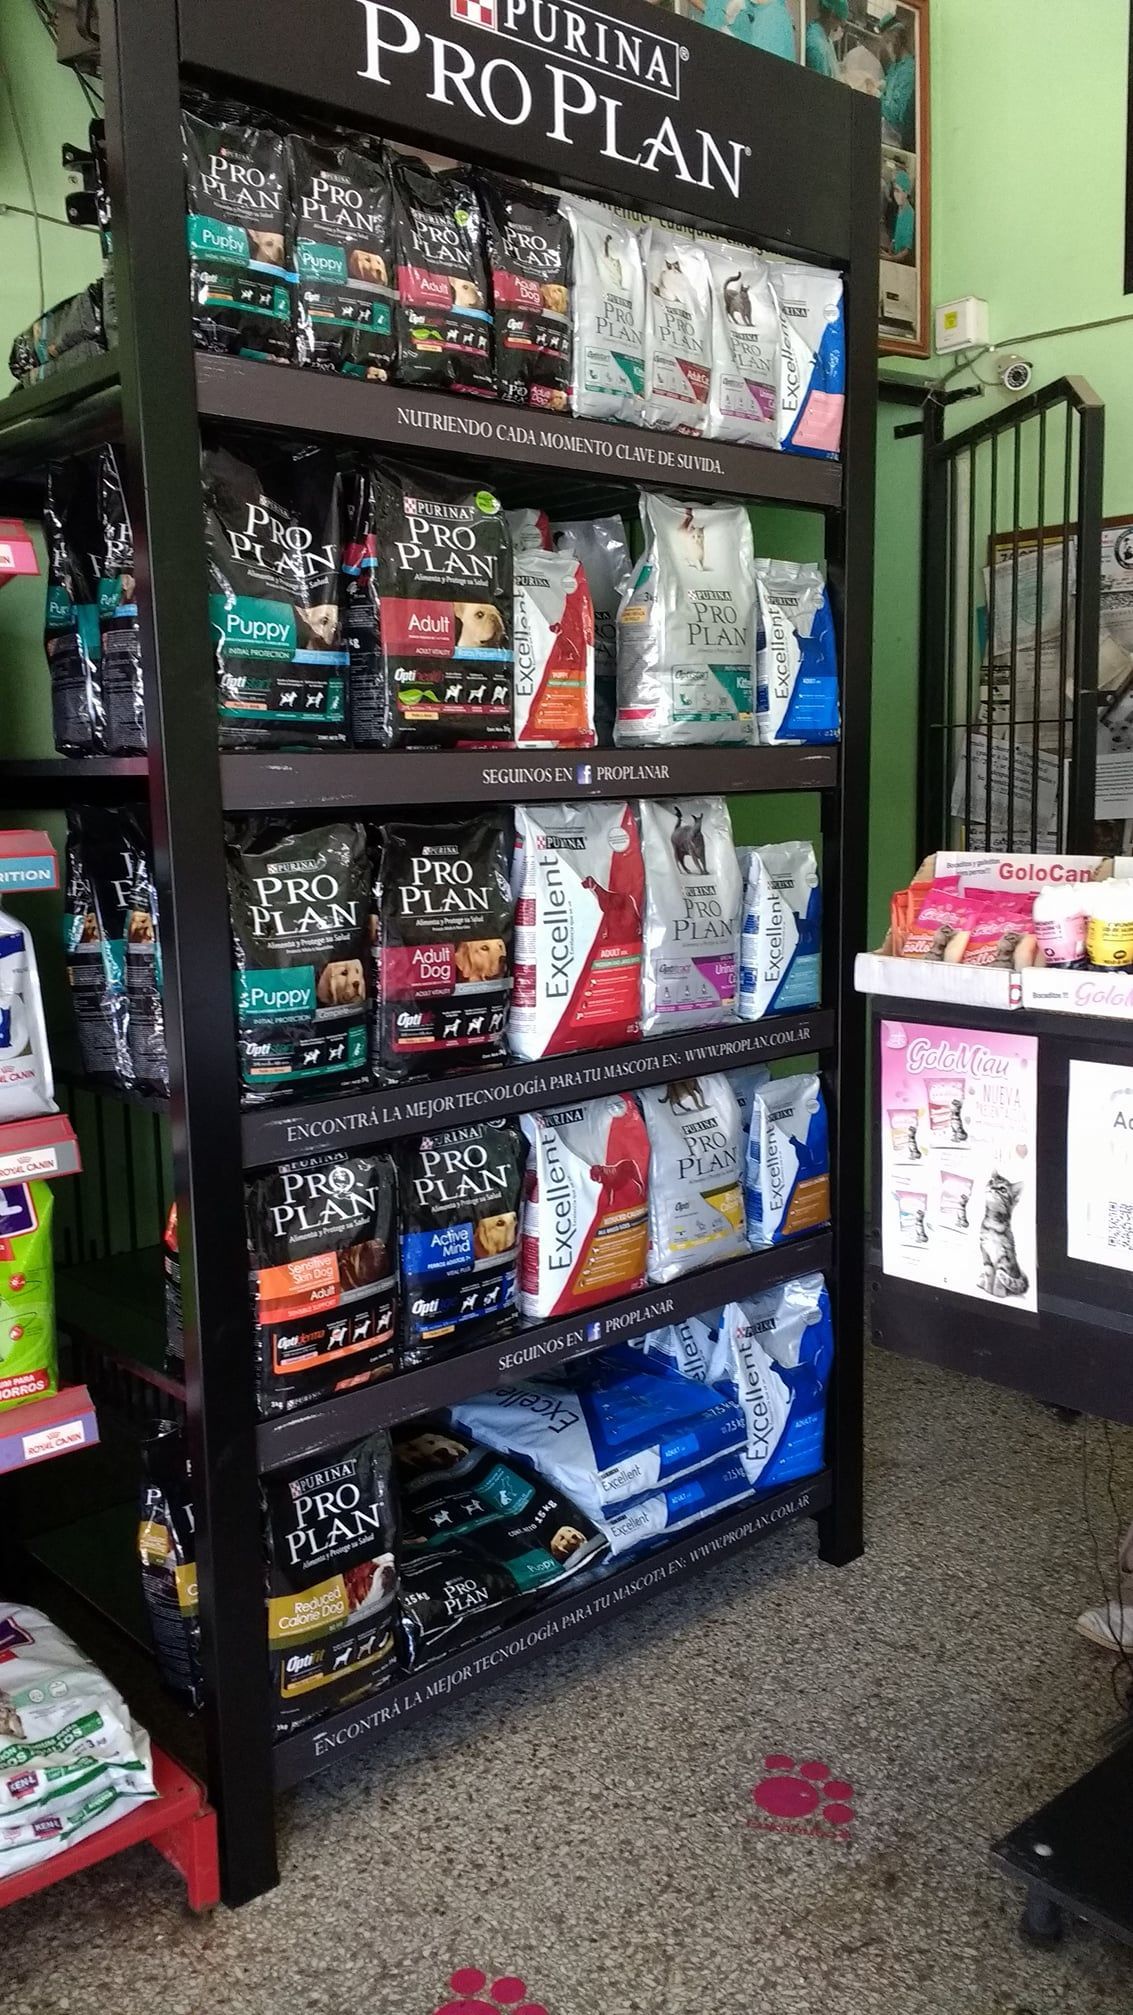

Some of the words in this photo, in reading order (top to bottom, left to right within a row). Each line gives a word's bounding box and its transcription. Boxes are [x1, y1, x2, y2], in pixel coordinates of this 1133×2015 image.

[357, 0, 532, 126] PRO
[208, 154, 265, 188] PRO
[199, 172, 283, 210] PLAN
[310, 176, 363, 209] PRO
[300, 196, 375, 233] PLAN
[202, 229, 245, 252] Puppy
[415, 221, 460, 246] PRO
[503, 225, 547, 251] PRO
[302, 252, 343, 272] Puppy
[502, 237, 563, 268] PLAN
[420, 278, 449, 295] Adult
[514, 276, 538, 291] Adult
[520, 288, 541, 304] Dog
[603, 301, 634, 326] PRO
[665, 312, 695, 336] PRO
[595, 316, 643, 345] PLAN
[659, 325, 705, 353] PLAN
[397, 407, 493, 438] NUTRIENDO
[496, 424, 536, 445] CADA
[540, 432, 613, 457] MOMENTO
[616, 444, 655, 464] CLAVE
[657, 450, 675, 467] DE
[417, 502, 469, 520] PURINA
[243, 502, 313, 551] PRO
[405, 515, 476, 551] PRO
[226, 529, 336, 583] PLAN
[394, 541, 497, 579] PLAN
[515, 576, 550, 588] PURINA
[696, 591, 732, 601] PURINA
[227, 614, 290, 641] Puppy
[408, 613, 451, 633] Adult
[692, 602, 738, 625] PRO
[513, 589, 537, 697] Excellent
[687, 622, 748, 647] PLAN
[769, 607, 790, 699] Excellent
[482, 767, 552, 784] SEGUINOS
[554, 767, 573, 782] EN
[597, 765, 670, 781] PROPLANAR
[278, 860, 314, 872] PURINA
[410, 857, 473, 885] PRO
[999, 862, 1092, 883] GoloCan
[252, 874, 339, 907] PRO
[398, 886, 490, 915] PLAN
[248, 901, 359, 936] PLAN
[683, 897, 723, 919] PRO
[540, 856, 574, 999] Excellent
[673, 919, 733, 941] PLAN
[765, 893, 784, 982] Excellent
[412, 947, 451, 964] Adult
[420, 964, 451, 980] Dog
[251, 988, 311, 1008] Puppy
[908, 1038, 1011, 1078] GoloMiau
[287, 1105, 380, 1142] ENCONTRÁ
[383, 1108, 401, 1124] LA
[405, 1095, 455, 1120] MEJOR
[457, 1075, 547, 1107] TECNOLOGÍA
[550, 1073, 582, 1091] PARA
[583, 1069, 600, 1083] TU
[603, 1056, 660, 1080] MASCOTA
[662, 1052, 681, 1067] EN:
[683, 1118, 718, 1134] PURINA
[685, 1132, 727, 1157] PRO
[26, 1160, 55, 1172] CANIN
[419, 1145, 487, 1177] PRO
[678, 1147, 737, 1179] PLAN
[767, 1125, 785, 1211] Excellent
[280, 1167, 355, 1204] PRO
[413, 1165, 508, 1206] PLAN
[270, 1187, 377, 1237] PLAN
[542, 1134, 578, 1270] Excellent
[431, 1229, 469, 1247] Active
[442, 1240, 471, 1257] Mind
[287, 1256, 332, 1275] Sensitive
[313, 1267, 334, 1281] Dog
[310, 1286, 335, 1301] Adult
[411, 1298, 440, 1317] Opti
[498, 1337, 564, 1371] SEGUINOS
[567, 1330, 583, 1347] EN
[605, 1300, 674, 1333] PROPLANAR
[739, 1340, 774, 1460] Excellent
[300, 1464, 352, 1489] PURINA
[601, 1464, 642, 1492] Excellent
[293, 1483, 360, 1530] PRO
[285, 1503, 382, 1565] PLAN
[610, 1511, 651, 1537] Excellent
[527, 1557, 555, 1573] Puppy
[294, 1586, 342, 1614] Reduced
[443, 1579, 477, 1599] PRO
[444, 1587, 489, 1616] PLAN
[278, 1610, 321, 1629] Calorie
[321, 1601, 344, 1617] Dog
[314, 1700, 401, 1757] ENCONTRÁ
[404, 1691, 423, 1711] LA
[426, 1665, 472, 1700] MEJOR
[473, 1621, 559, 1674] TECNOLOGÍA
[561, 1605, 592, 1630] PARA
[592, 1593, 610, 1613] TU
[612, 1566, 666, 1603] MASCOTA
[668, 1558, 687, 1574] EN:
